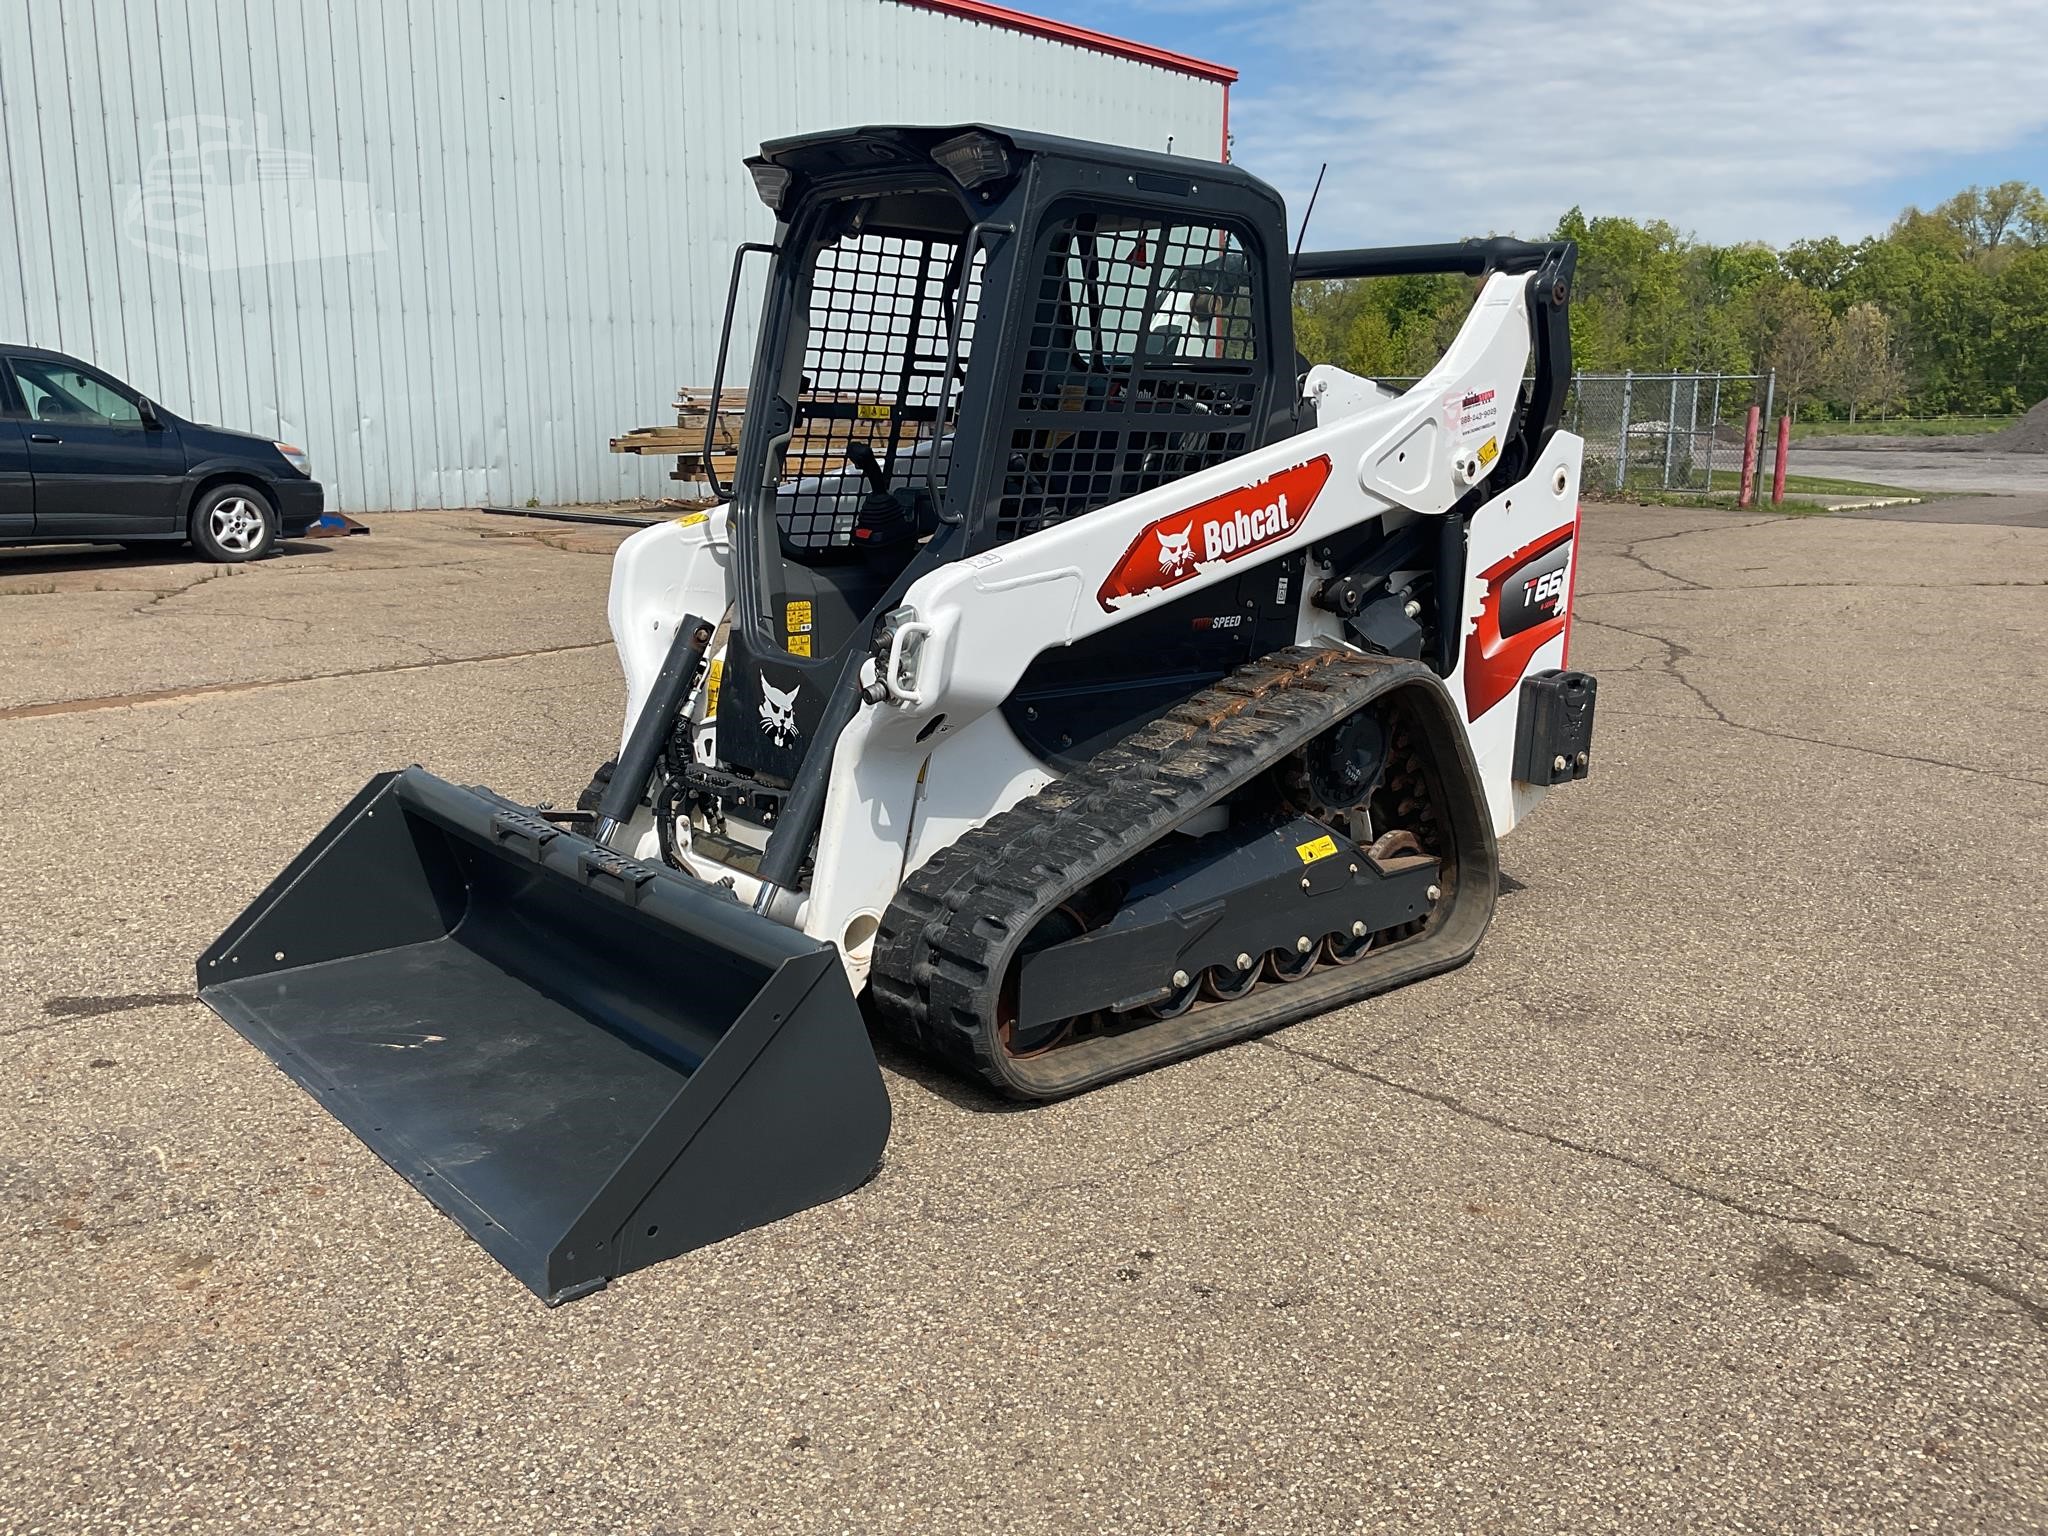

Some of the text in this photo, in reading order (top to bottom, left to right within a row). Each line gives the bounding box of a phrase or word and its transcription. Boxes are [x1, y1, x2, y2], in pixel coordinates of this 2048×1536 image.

[1203, 493, 1290, 561] Bobcat
[1523, 568, 1564, 607] T66
[1212, 615, 1241, 629] SPEED
